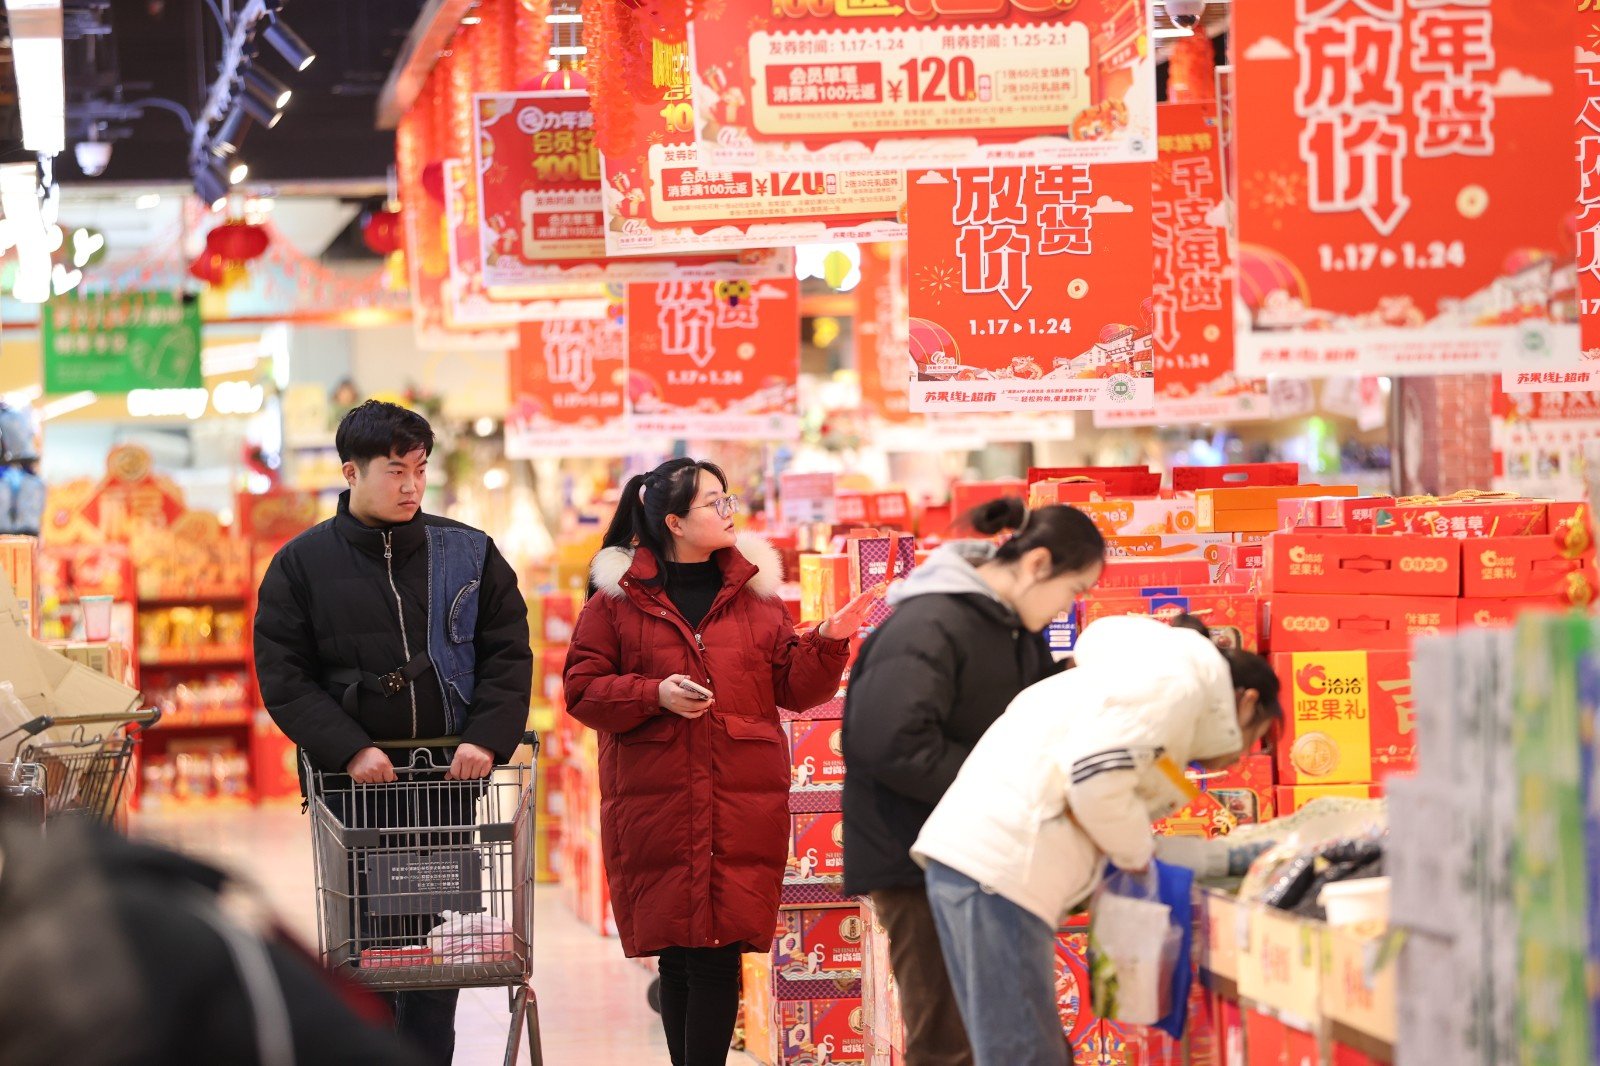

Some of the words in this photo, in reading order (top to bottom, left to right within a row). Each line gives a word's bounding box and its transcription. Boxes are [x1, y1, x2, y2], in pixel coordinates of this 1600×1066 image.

[1294, 0, 1412, 237] 放价
[1318, 243, 1379, 271] 1.17
[1401, 241, 1466, 269] 1.24
[969, 320, 1010, 336] 1.17
[1028, 318, 1072, 335] 1.24
[1517, 371, 1591, 385] 苏果线上超市
[924, 391, 997, 404] 苏果线上超市
[1434, 515, 1484, 531] 含羞草
[1327, 678, 1362, 695] 洽洽
[1297, 698, 1367, 721] 坚果礼
